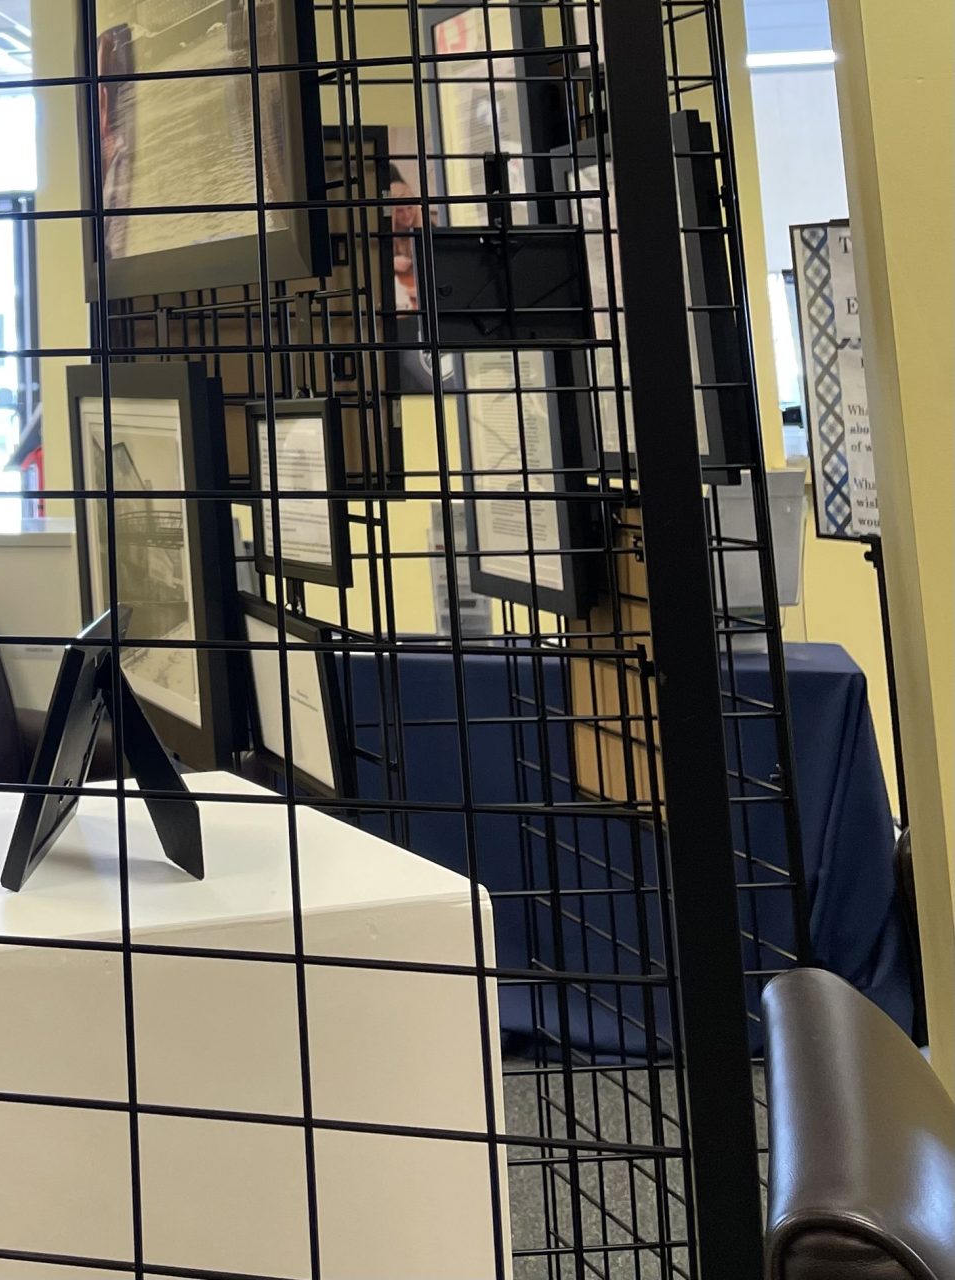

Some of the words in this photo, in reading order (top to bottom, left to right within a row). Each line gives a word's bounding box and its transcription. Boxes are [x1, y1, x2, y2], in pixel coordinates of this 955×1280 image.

[850, 423, 869, 434] abo
[851, 441, 862, 452] of
[858, 519, 880, 528] wou
